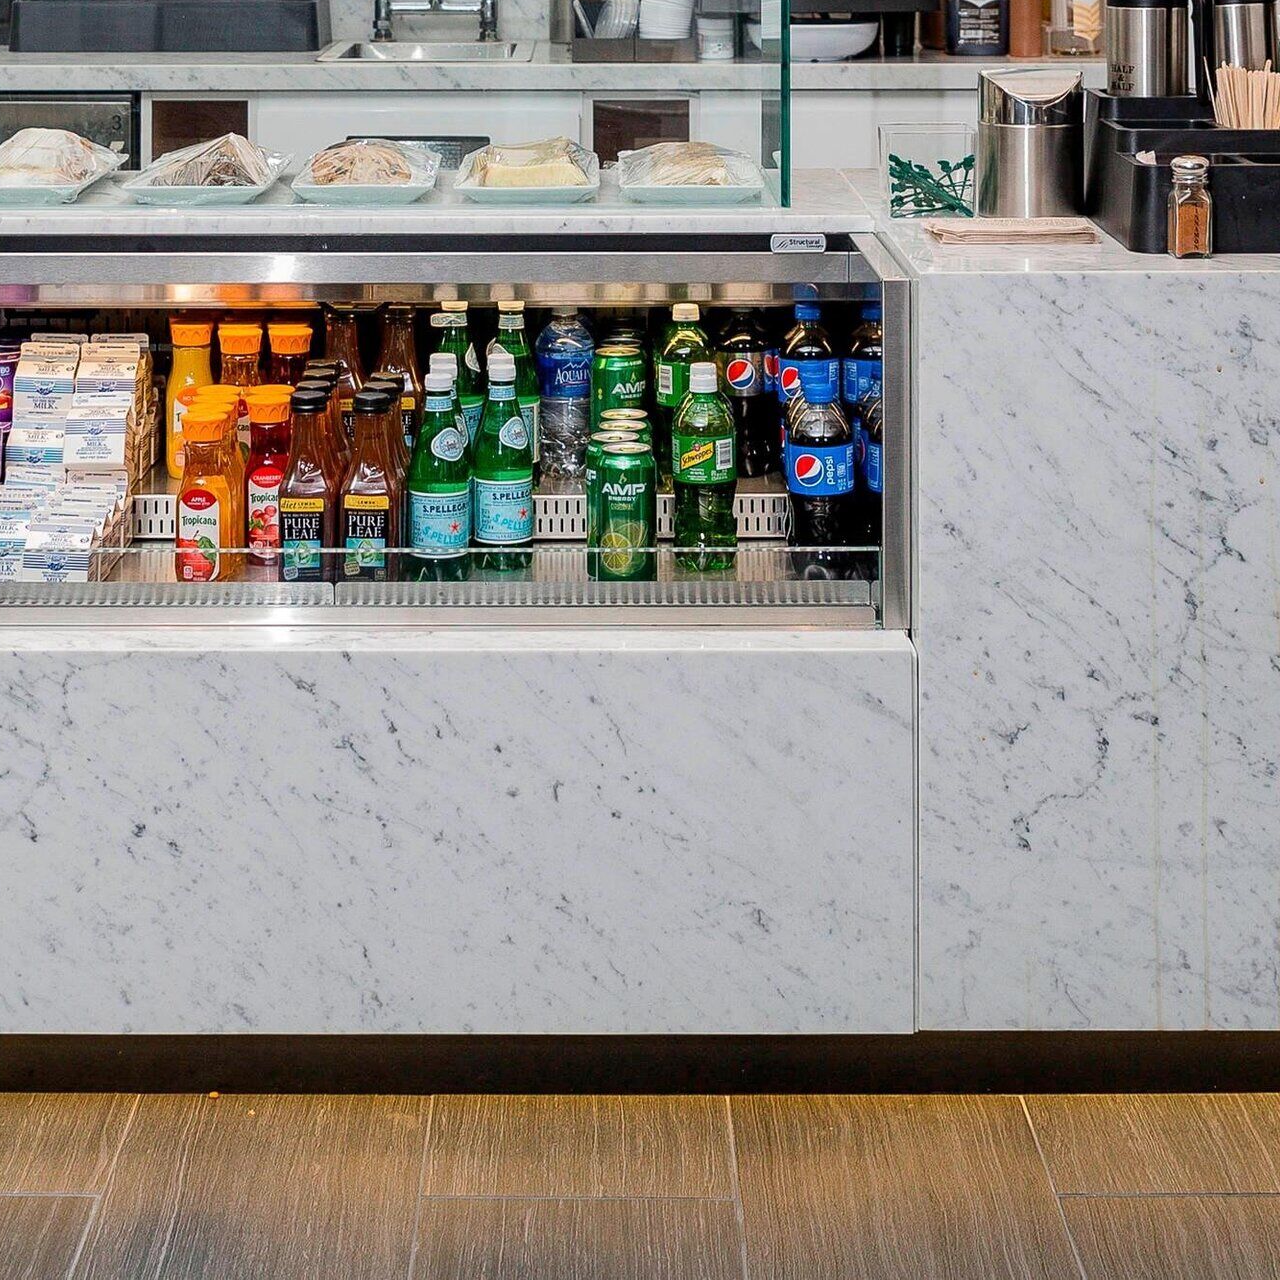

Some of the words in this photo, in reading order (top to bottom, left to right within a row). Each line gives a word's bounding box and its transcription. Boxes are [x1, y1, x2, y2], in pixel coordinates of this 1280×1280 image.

[1111, 63, 1135, 74] HALF
[1111, 81, 1135, 92] HALF
[112, 114, 122, 130] 3
[789, 238, 820, 246] Structural
[681, 447, 713, 466] Schweppes
[825, 455, 836, 486] pepsi
[601, 482, 646, 496] AMP
[181, 515, 217, 527] Tropicana
[284, 517, 320, 529] PURE
[348, 515, 385, 527] PURE
[284, 529, 318, 540] LEAF
[348, 526, 382, 538] LEAF
